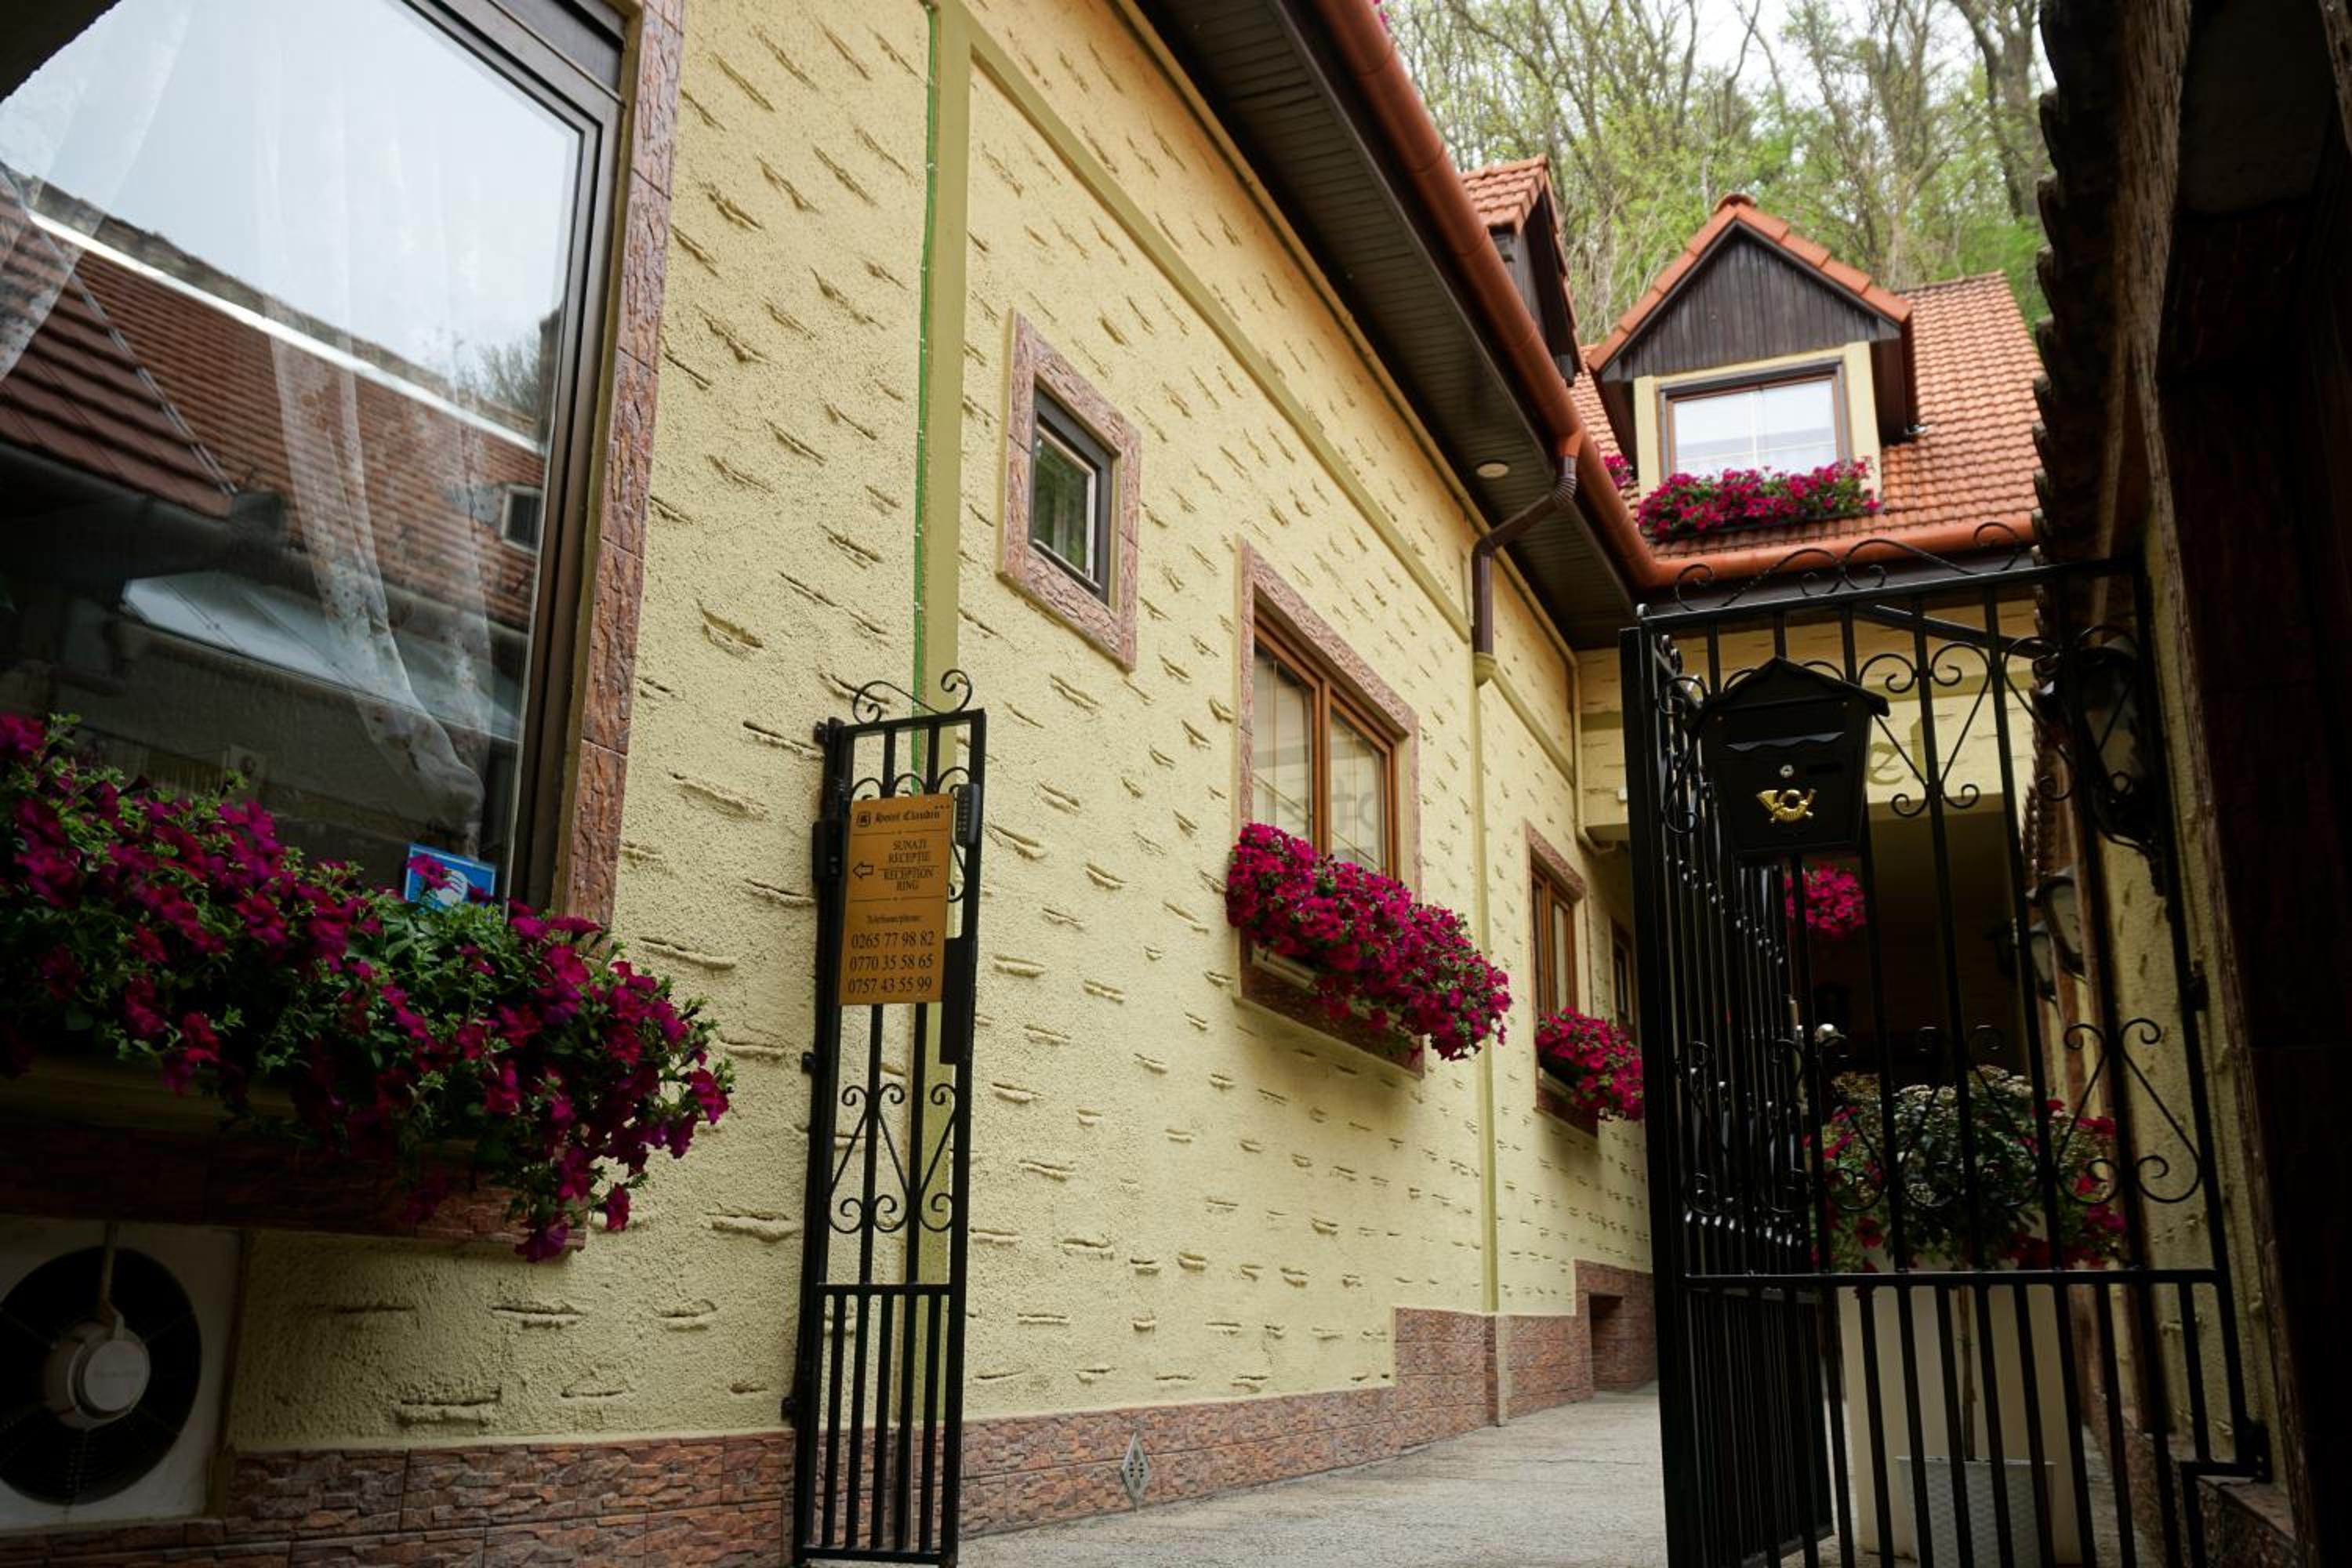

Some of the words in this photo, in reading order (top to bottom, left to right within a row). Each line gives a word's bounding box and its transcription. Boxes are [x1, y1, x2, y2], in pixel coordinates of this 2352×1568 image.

[884, 868, 934, 880] RECEPTION
[896, 880, 919, 891] RING
[851, 933, 880, 949] 0265
[884, 932, 899, 947] 77
[902, 931, 916, 947] 98
[920, 930, 935, 946] 82
[849, 956, 879, 972] 0770
[899, 953, 915, 970] 58
[918, 953, 934, 968] 65
[848, 978, 877, 994] 0757
[880, 977, 895, 993] 43
[898, 976, 914, 992] 55
[916, 975, 932, 992] 99
